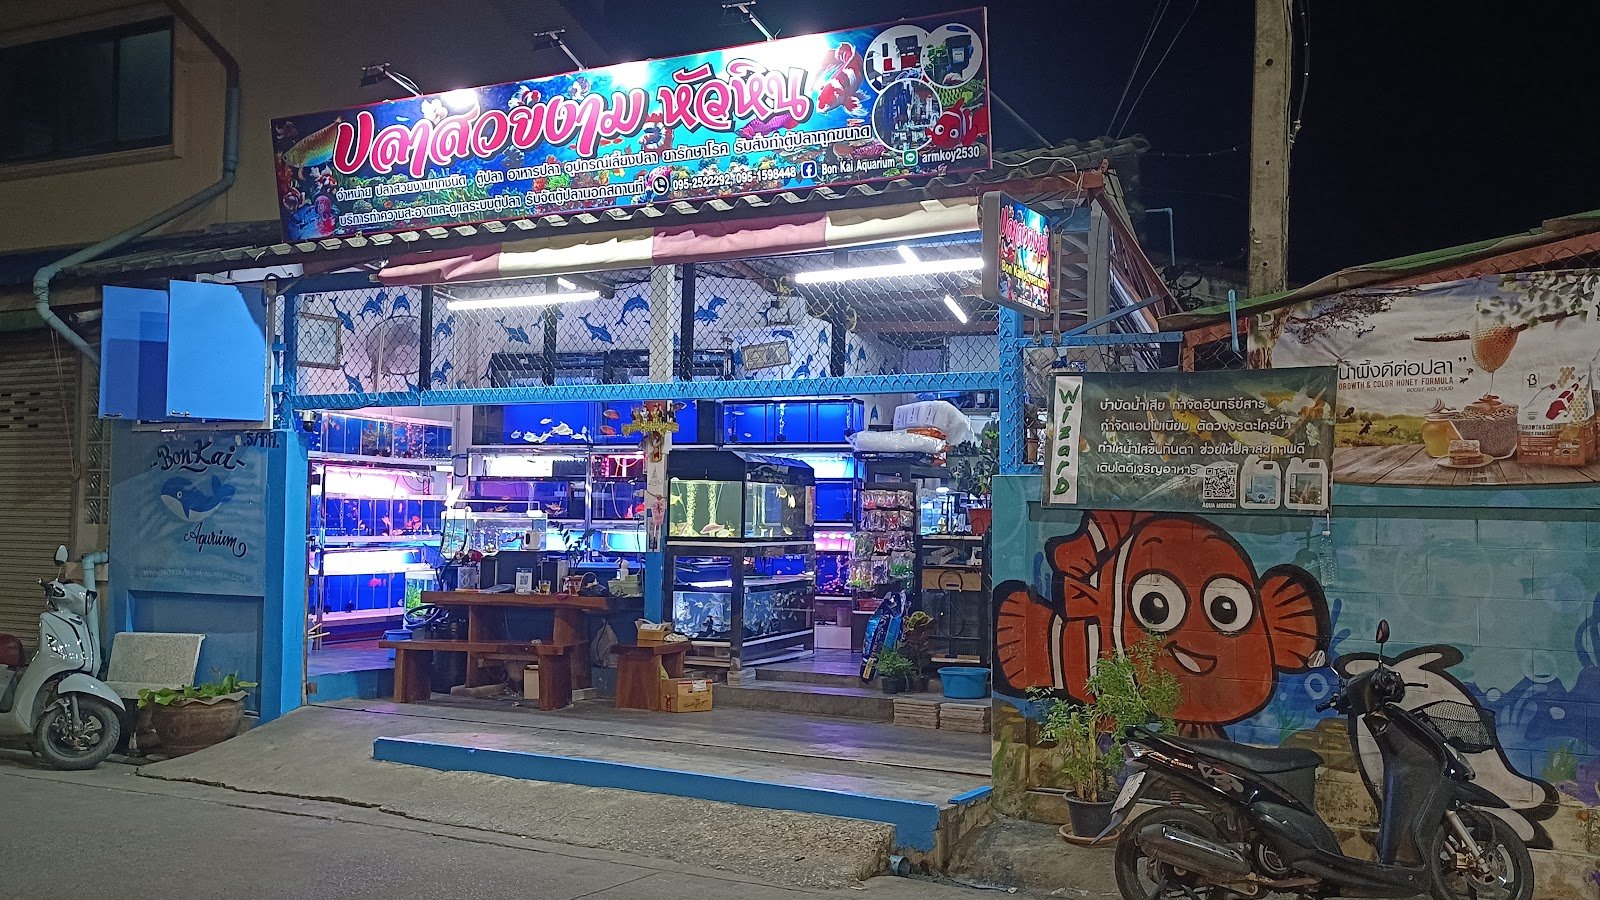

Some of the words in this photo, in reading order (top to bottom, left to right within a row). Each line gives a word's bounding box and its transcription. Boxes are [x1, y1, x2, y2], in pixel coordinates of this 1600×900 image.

[331, 86, 648, 177] ปลาสวยงาม
[656, 58, 813, 133] หัวหิน
[335, 184, 372, 201] จำหน่าย
[375, 174, 467, 196] ปลาสวยงามทุกชนิด
[475, 169, 503, 187] ตู้ปลา
[506, 162, 561, 180] อาหารปลา
[565, 151, 658, 177] อุปกรณ์เลี้ยงปลา
[662, 139, 729, 162] ยารักษาโรค
[733, 125, 872, 154] รับสั่งทำตู้ปลาทุกขนาด
[339, 194, 521, 226] บริการทำความสะอาดและดูแลระบบตู้ปลา
[526, 176, 645, 206] รับจัดตู้ปลานอกสถานที่
[735, 166, 796, 182] 095-1598448
[821, 163, 837, 175] Bon
[840, 161, 854, 173] Kai
[856, 158, 896, 174] Aquarium
[921, 145, 980, 164] armkoy2530
[1338, 381, 1365, 390] GROWTH
[1373, 380, 1394, 388] COLOR
[1396, 379, 1418, 387] HONEY
[1421, 377, 1454, 385] FORMULA
[1100, 395, 1165, 411] บำบัดน้ำเสีย
[1172, 397, 1267, 411] กำจัดอินทรีย์สาร
[1100, 419, 1190, 432] กำจัดแอมโมเนียม
[1098, 439, 1194, 455] ทำให้น้ำใสขึ้นทันตา
[1200, 442, 1305, 457] ช่วยให้ปลาสุขภาพดี
[1096, 462, 1197, 476] เติบโตดีเจริญอาหาร
